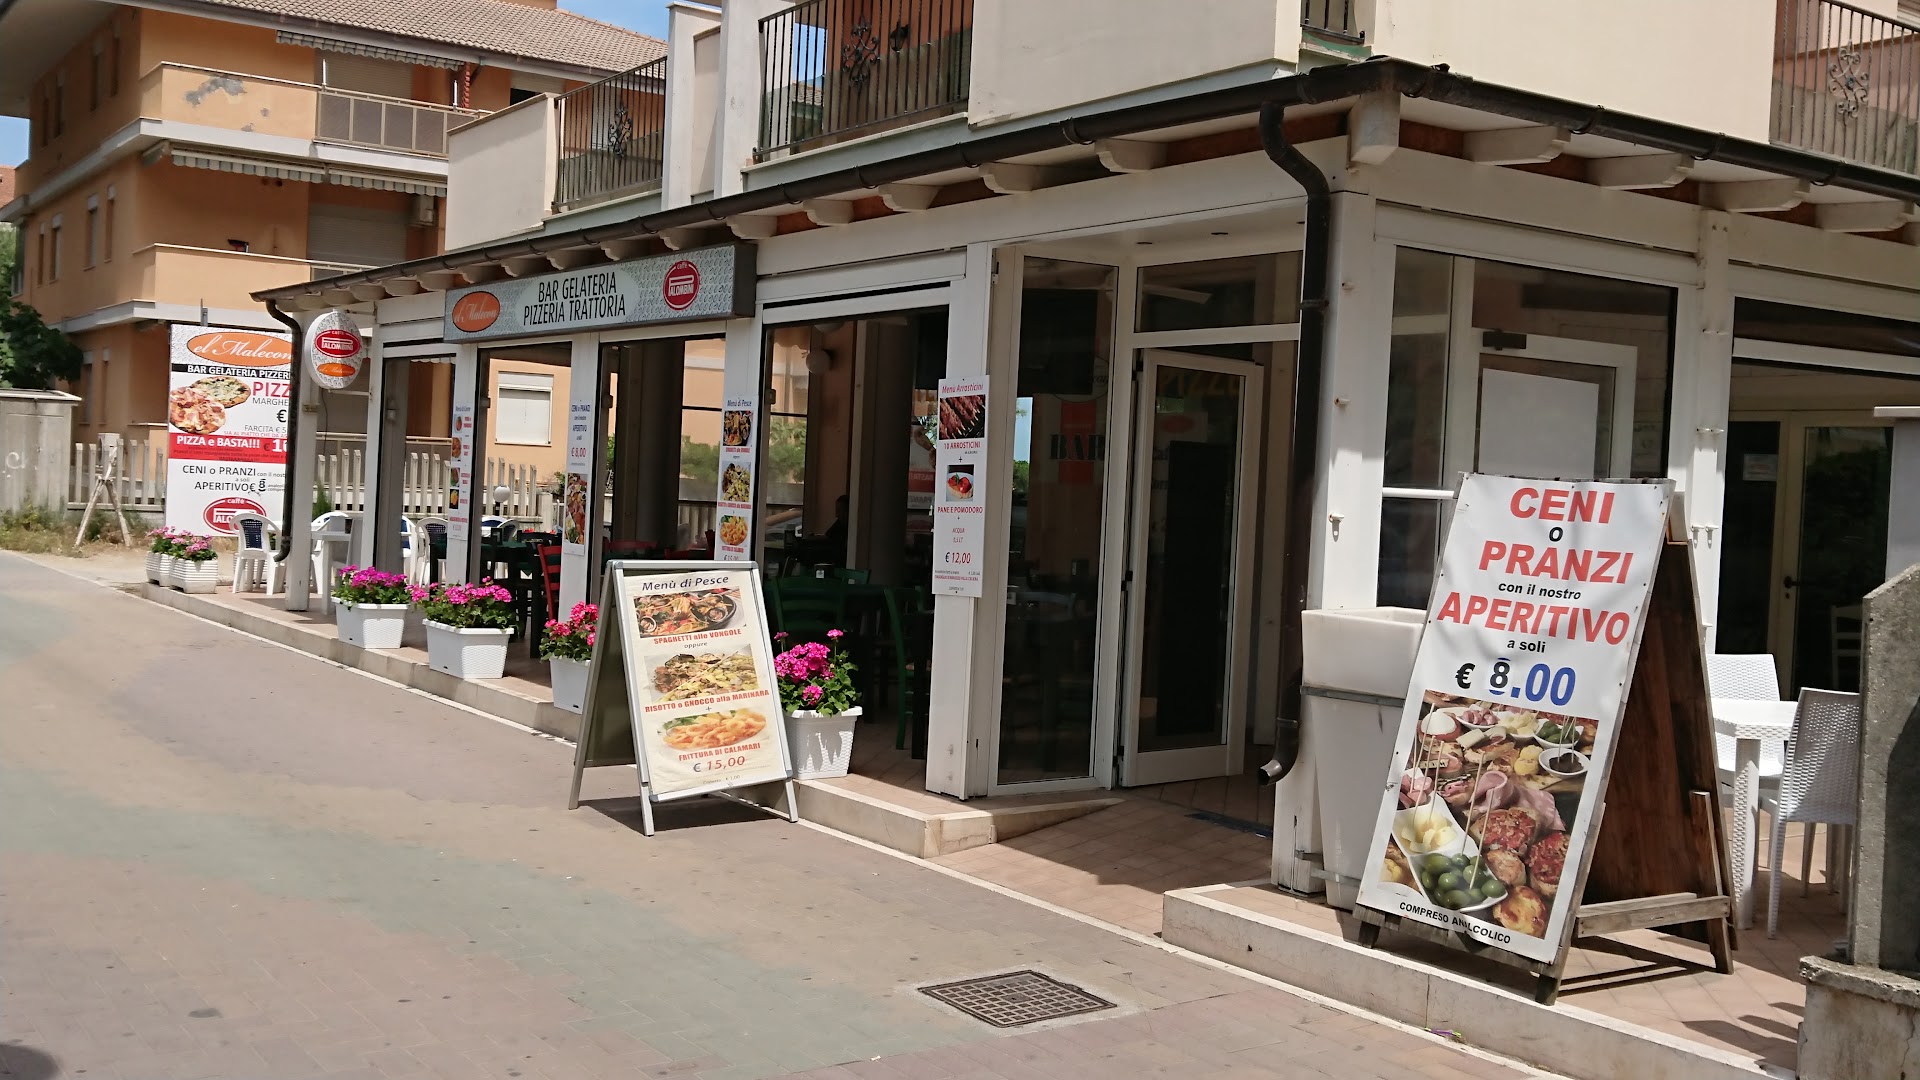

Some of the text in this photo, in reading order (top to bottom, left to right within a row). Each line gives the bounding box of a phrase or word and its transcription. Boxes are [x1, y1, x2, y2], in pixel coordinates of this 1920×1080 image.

[538, 272, 616, 302] BAR GELATERIA
[668, 274, 694, 296] PALOMBINI
[524, 294, 626, 326] PIZZERIA TRATTORIA
[193, 334, 222, 354] el
[322, 336, 354, 350] PALOMBINI
[188, 364, 206, 374] BAR
[208, 366, 257, 378] GELATERIA
[942, 382, 984, 394] Menù Arrosticini
[276, 410, 286, 422] €
[176, 436, 206, 446] PIZZA
[217, 438, 260, 448] BASTA!!!
[264, 443, 270, 452] €
[950, 441, 980, 449] ARROSTICINI
[182, 464, 206, 474] CENI
[219, 466, 256, 476] PRANZI
[938, 506, 950, 514] PANE
[1510, 487, 1615, 524] CENI
[1548, 526, 1564, 542] o
[945, 552, 971, 564] € 12,00
[1478, 540, 1634, 584] PRANZI
[642, 576, 729, 591] Menù di Pesce
[1498, 582, 1582, 600] con il nostro
[1436, 591, 1630, 646] APERITIVO
[654, 634, 692, 644] SPAGHETTI
[710, 628, 742, 638] VONGOLE
[1507, 639, 1546, 653] a soli
[1454, 663, 1476, 690] €
[645, 703, 676, 713] RISOTTO
[684, 698, 715, 707] GNOCCO
[732, 690, 770, 701] MARINARA
[679, 751, 714, 762] FRITTURA
[724, 742, 761, 754] CALAMARI
[693, 756, 745, 772] € 15,00
[1399, 902, 1450, 923] COMPRESO
